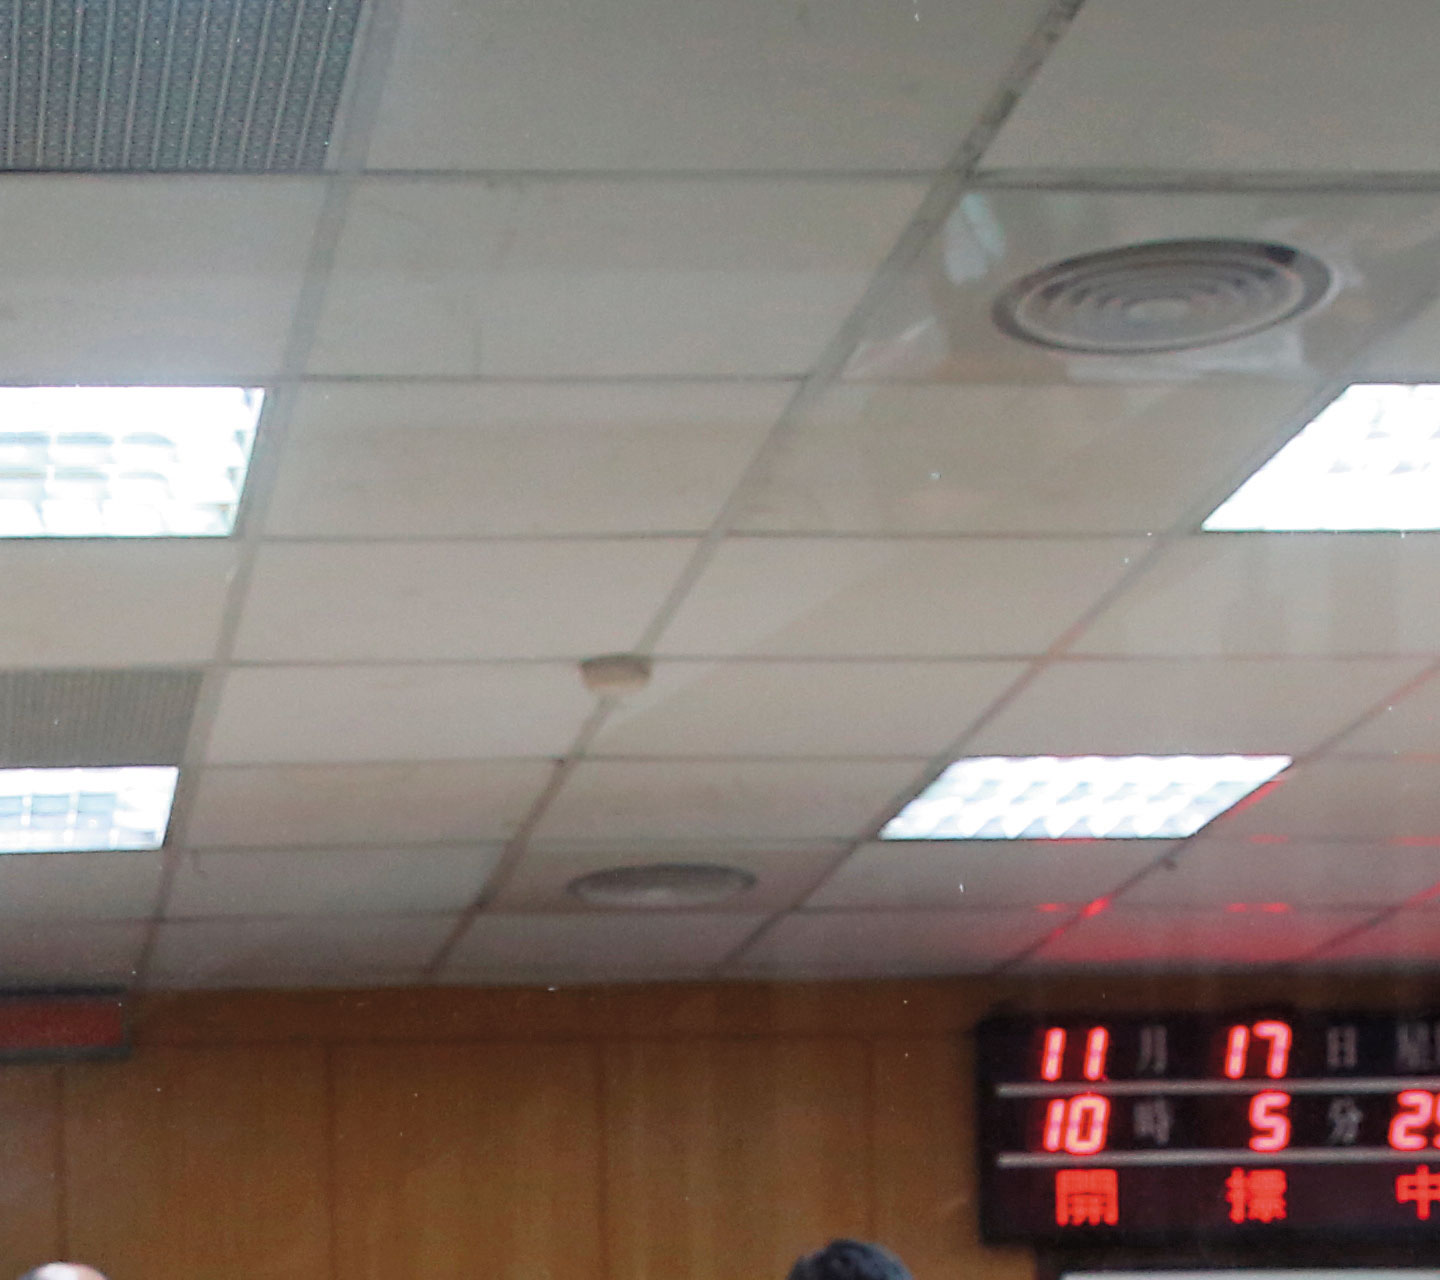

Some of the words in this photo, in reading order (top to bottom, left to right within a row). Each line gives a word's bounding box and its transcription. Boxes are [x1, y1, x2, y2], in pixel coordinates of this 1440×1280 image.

[1041, 1028, 1108, 1080] 11
[1225, 1021, 1292, 1079] 17
[1043, 1095, 1110, 1155] 10
[1249, 1090, 1291, 1152] 5
